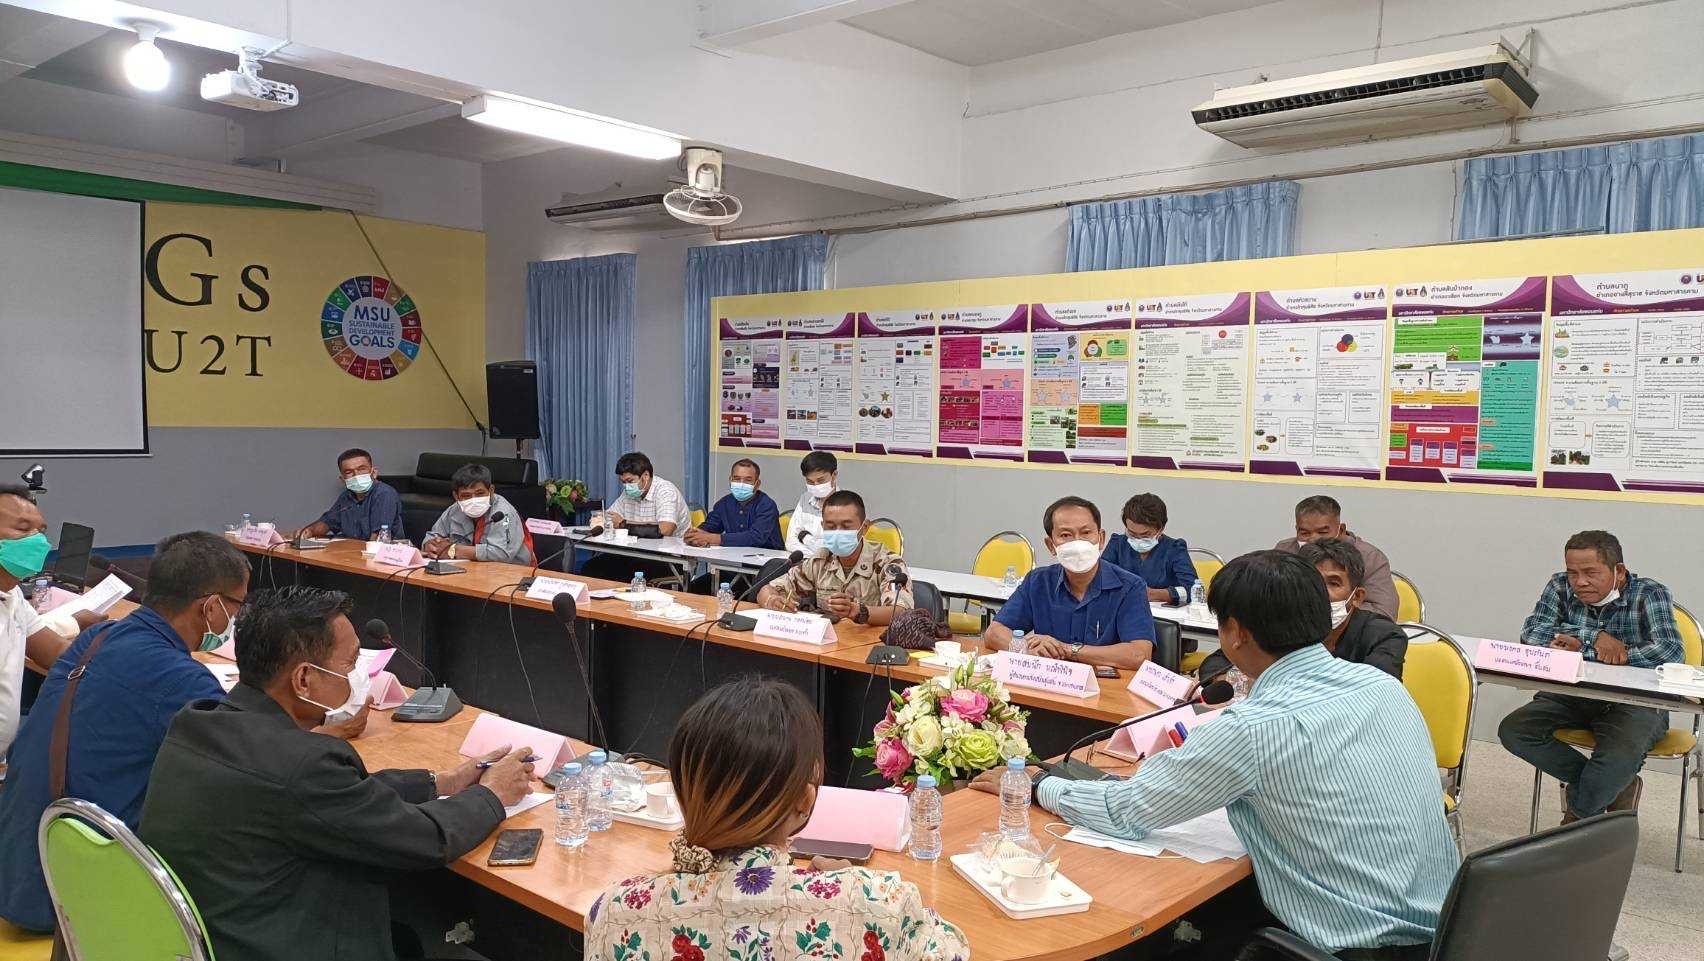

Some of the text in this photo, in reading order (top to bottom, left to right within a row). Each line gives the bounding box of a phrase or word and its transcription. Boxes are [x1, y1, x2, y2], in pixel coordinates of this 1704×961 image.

[354, 305, 390, 321] MSU
[349, 320, 395, 330] SUSTAINABLE
[349, 327, 395, 336] DEVELOPMENT
[349, 334, 395, 348] GOALS
[144, 329, 272, 377] U2T
